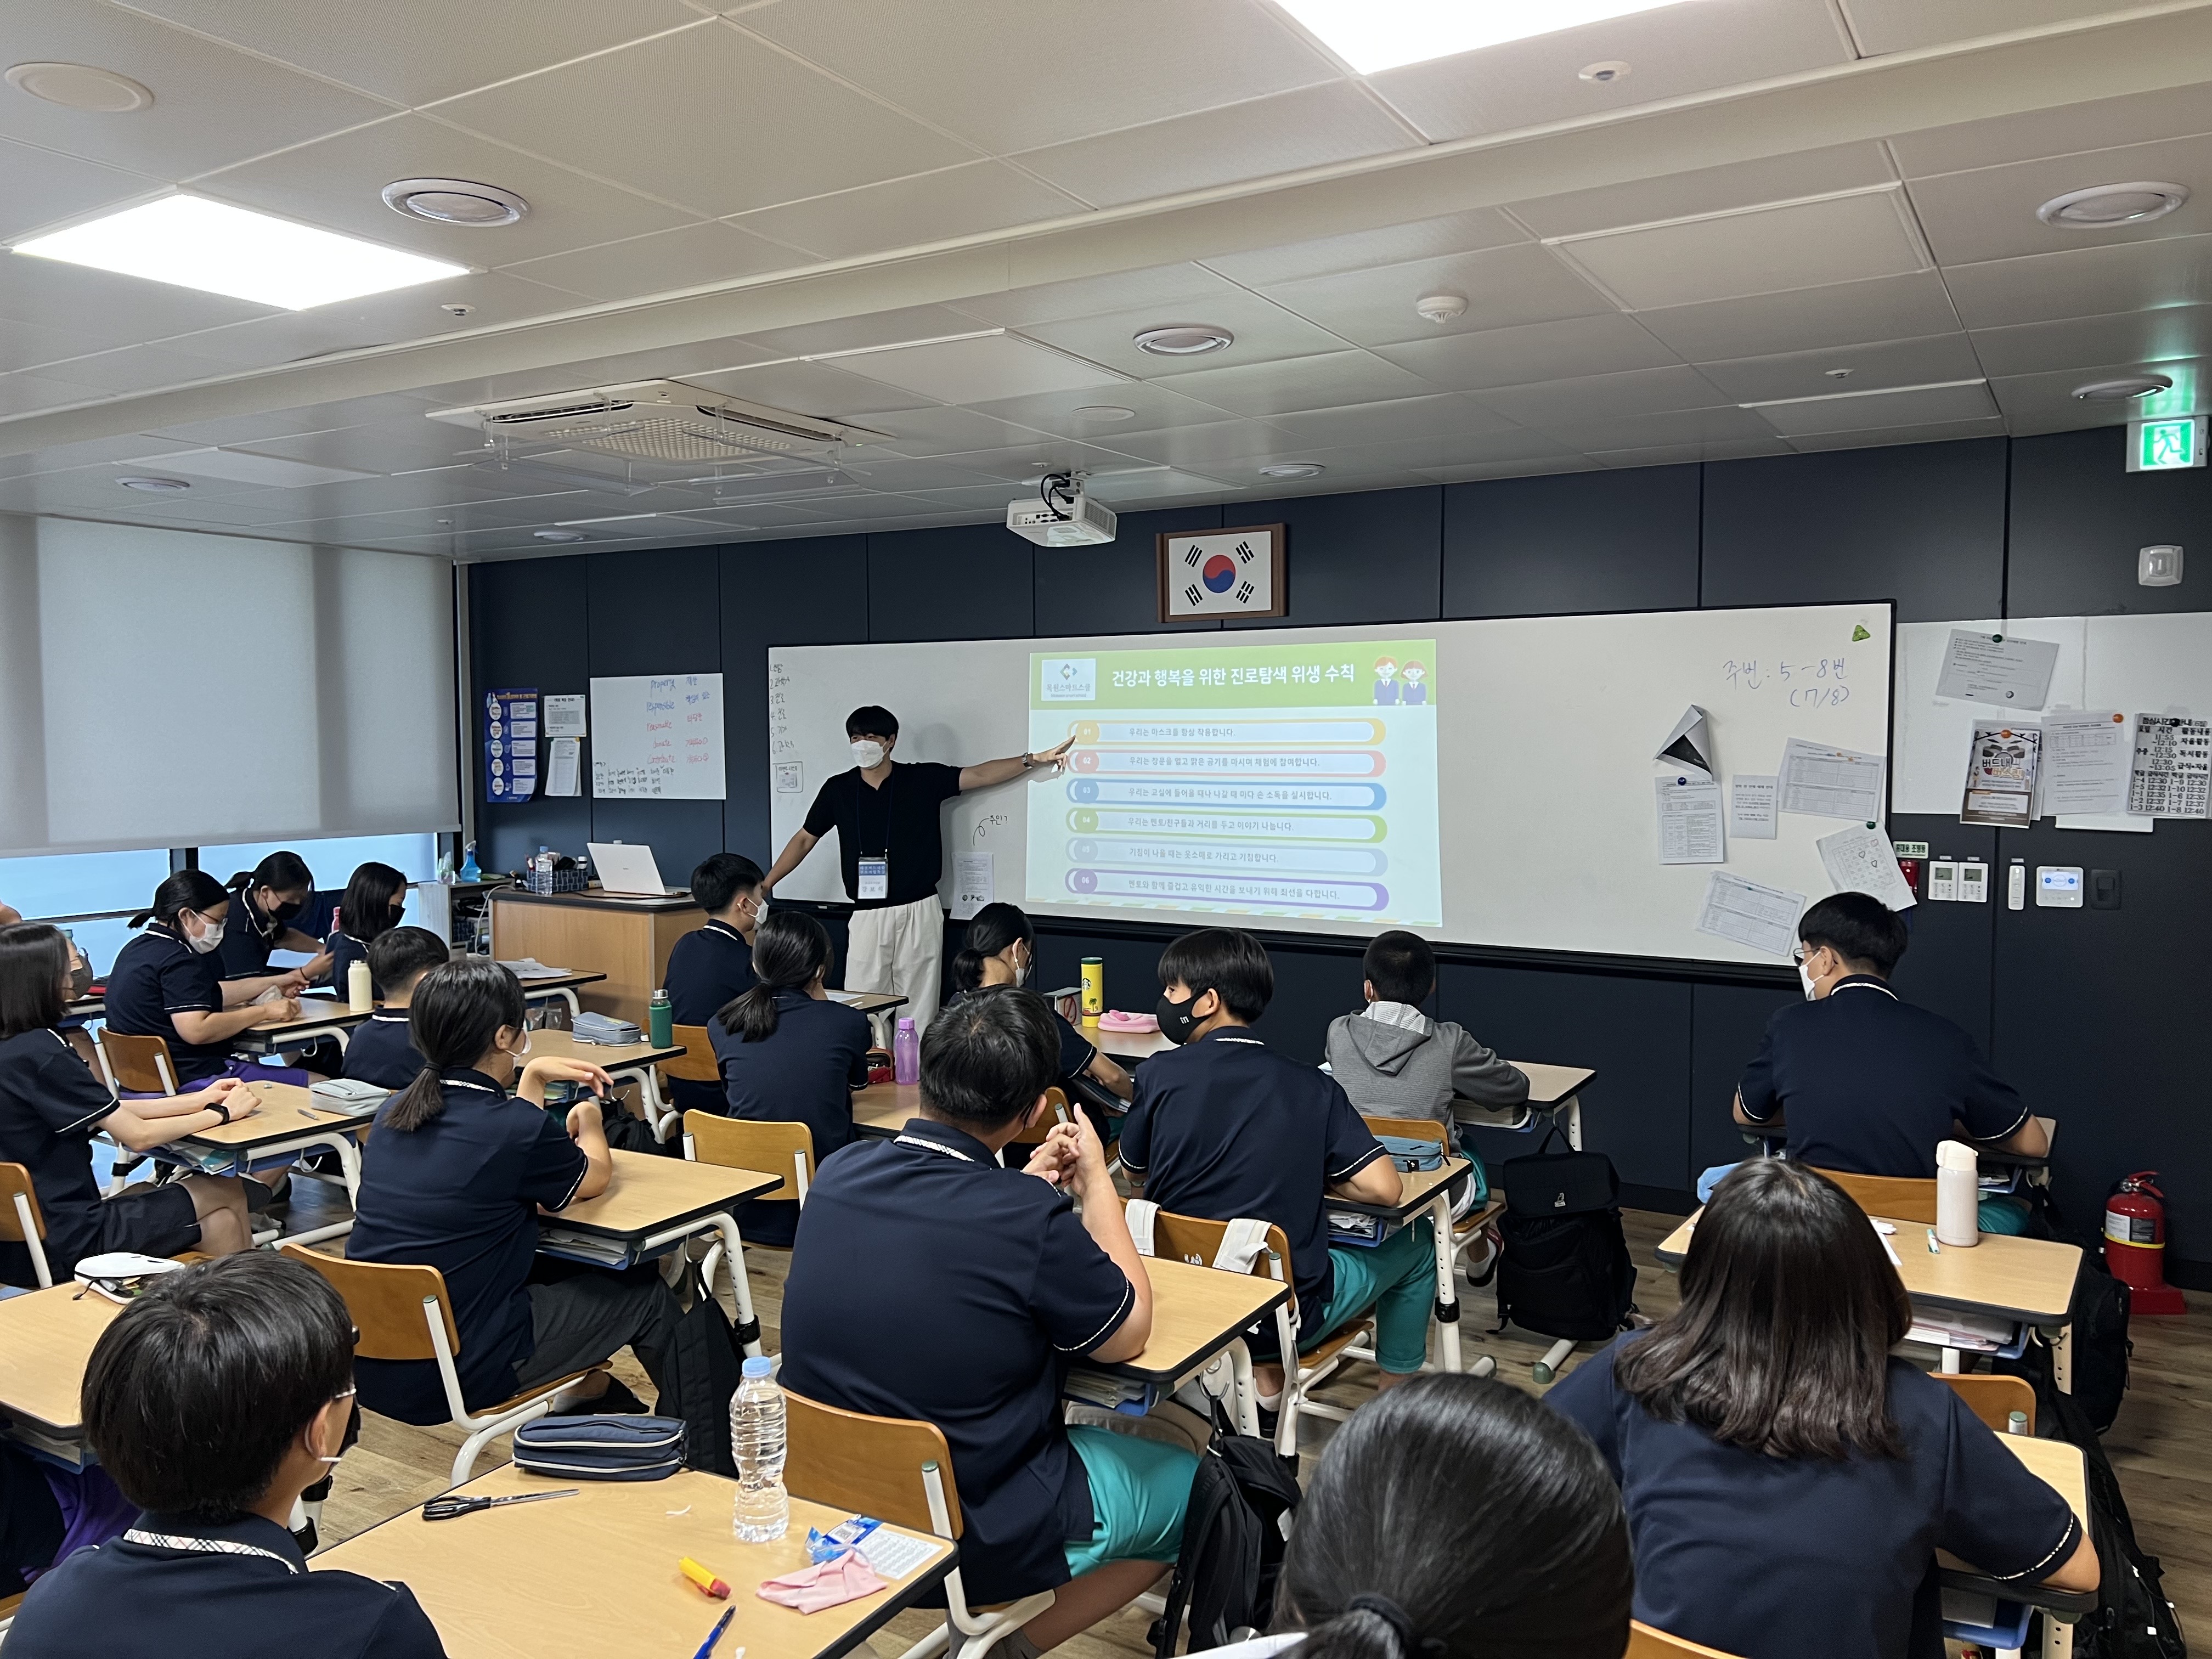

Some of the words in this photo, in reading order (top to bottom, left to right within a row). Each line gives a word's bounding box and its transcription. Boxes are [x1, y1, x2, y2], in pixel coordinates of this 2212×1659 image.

[1112, 670, 1151, 687] 건강과
[1154, 669, 1195, 687] 행복을
[1199, 668, 1226, 685] 위한
[1231, 666, 1286, 685] 진로탐색
[1291, 665, 1321, 684] 위생
[1324, 664, 1354, 682] 수칙
[1790, 685, 1849, 709] (7/8)
[1129, 728, 1149, 736] 우리는
[1151, 728, 1178, 736] 마스크를
[1181, 728, 1195, 736] 항상
[1197, 728, 1235, 736] 착용합니다.
[1129, 757, 1149, 765] 우리는
[1152, 757, 1172, 765] 창문을
[1190, 758, 1205, 766] 맑은
[1207, 758, 1228, 766] 공기를
[1231, 758, 1252, 766] 마시며
[1255, 758, 1277, 766] 체험에
[1279, 758, 1320, 766] 참여합니다.
[1129, 788, 1149, 796] 우리는
[1151, 788, 1172, 797] 교실에
[1197, 789, 1211, 798] 때나
[1214, 790, 1228, 798] 나갈
[1240, 791, 1254, 799] 마다
[1266, 791, 1289, 799] 소독을
[1291, 791, 1333, 800] 실시합니다.
[1128, 817, 1148, 826] 우리는
[1197, 820, 1217, 829] 거리를
[1221, 821, 1235, 830] 두고
[1237, 821, 1259, 830] 이야기
[1130, 848, 1150, 857] 기침이
[1168, 850, 1182, 859] 때는
[1184, 850, 1213, 860] 옷소매로
[1215, 851, 1237, 861] 가리고
[1239, 853, 1279, 862] 기침합니다.
[1896, 844, 1910, 853] 휴대용
[1911, 844, 1926, 853] 조명등
[1128, 879, 1149, 889] 멘토와
[1151, 881, 1165, 890] 함께
[1167, 882, 1188, 891] 즐겁고
[1190, 883, 1212, 893] 유익한
[1214, 884, 1235, 894] 시간을
[1238, 886, 1261, 896] 보내기
[1263, 887, 1278, 896] 위해
[1280, 888, 1302, 898] 최선을
[1306, 889, 1340, 899] 다합니다.
